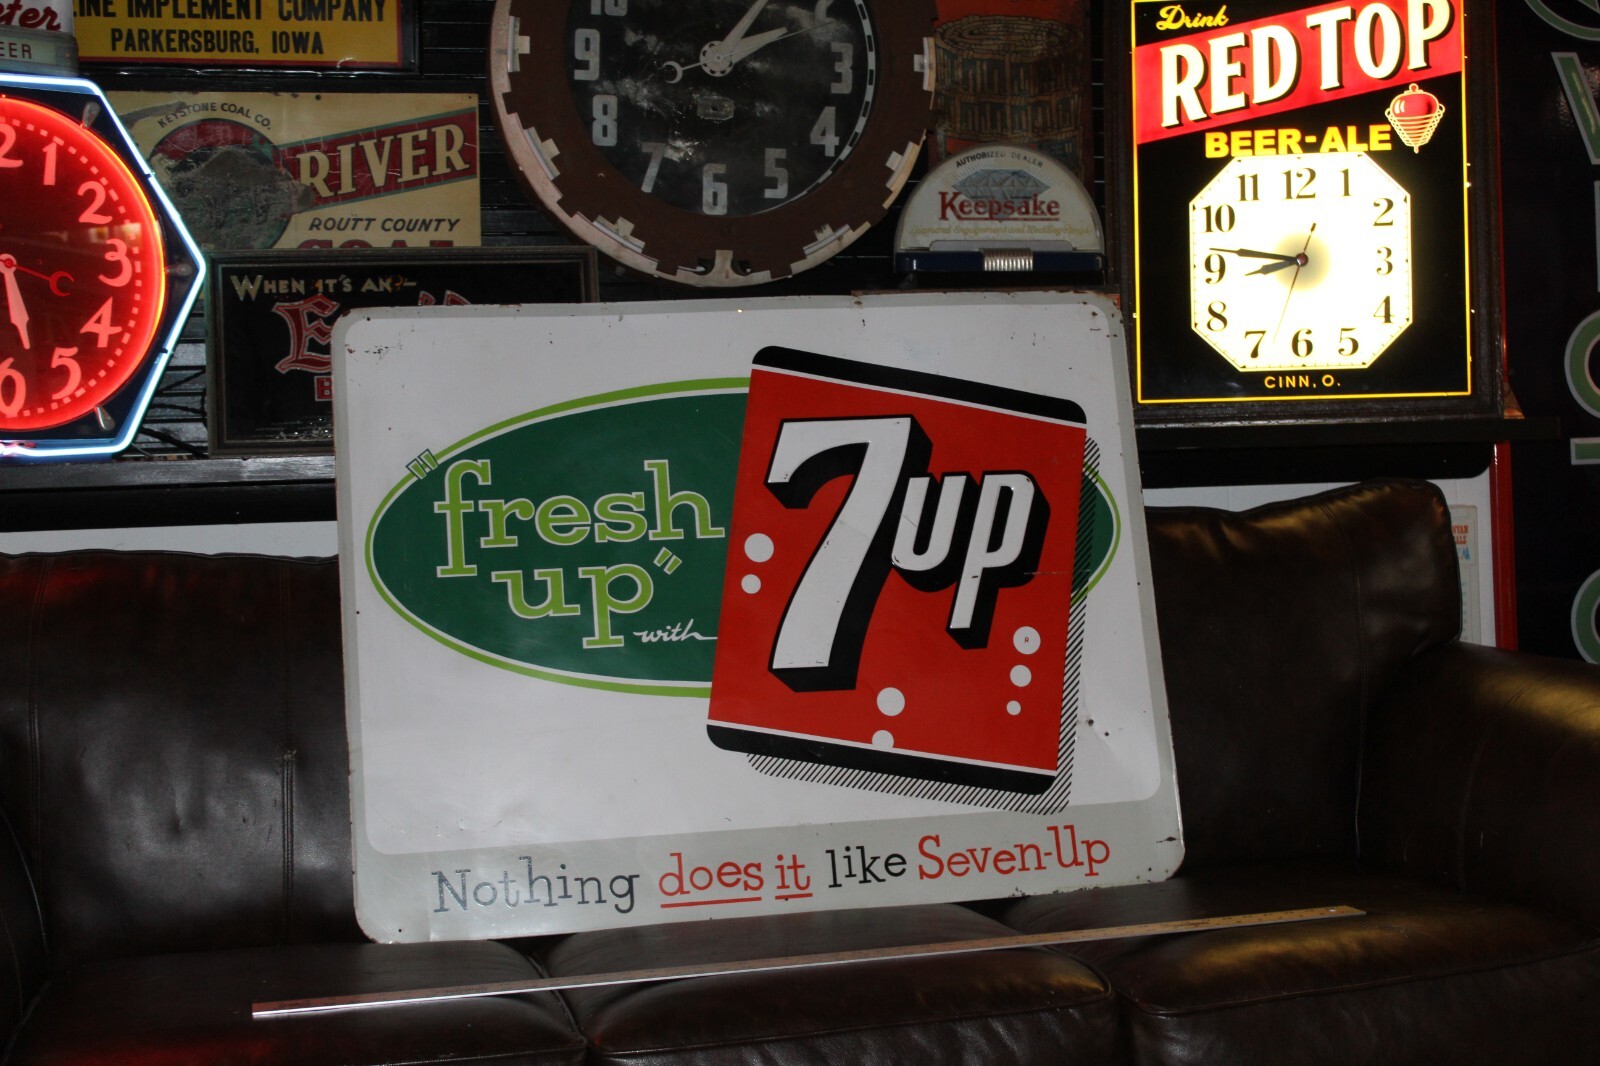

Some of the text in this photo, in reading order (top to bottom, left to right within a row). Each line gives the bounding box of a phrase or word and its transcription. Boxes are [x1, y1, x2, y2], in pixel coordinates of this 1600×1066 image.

[127, 0, 263, 20] IMPLEMENT
[278, 0, 386, 22] COMPANY
[1156, 5, 1229, 30] Drink
[111, 28, 324, 54] PARKERSBURG, IOWA
[573, 28, 601, 81] 9
[830, 41, 854, 95] 3
[1159, 0, 1451, 128] RED TOP
[157, 102, 271, 130] KEYSTONE COAL CO.
[592, 94, 618, 147] 8
[809, 106, 840, 157] 4
[1204, 124, 1392, 158] BEER-ALE
[42, 141, 57, 185] 1
[296, 123, 470, 199] RIVER
[641, 142, 669, 193] 7
[764, 147, 789, 199] 5
[956, 150, 1044, 168] AUTHORIZED DEALER
[702, 163, 728, 216] 6
[1237, 173, 1260, 201] 11
[1281, 167, 1317, 199] 12
[1339, 168, 1351, 198] 1
[77, 180, 113, 225] 2
[938, 191, 1061, 222] Keepsake
[1201, 203, 1236, 233] 10
[1373, 197, 1394, 227] 2
[308, 217, 461, 233] ROUTT COUNTY
[99, 238, 133, 288] 3
[1204, 253, 1225, 284] 9
[1376, 246, 1394, 275] 3
[229, 274, 305, 302] WHEN
[315, 274, 353, 293] IT'S
[80, 298, 122, 348] 4
[1206, 300, 1228, 332] 8
[1373, 295, 1395, 324] 4
[1244, 330, 1267, 359] 7
[1291, 328, 1313, 358] 6
[1337, 327, 1359, 357] 5
[51, 346, 82, 400] 5
[633, 619, 717, 643] with
[431, 824, 1111, 914] Nothing does it like Seven-Up
